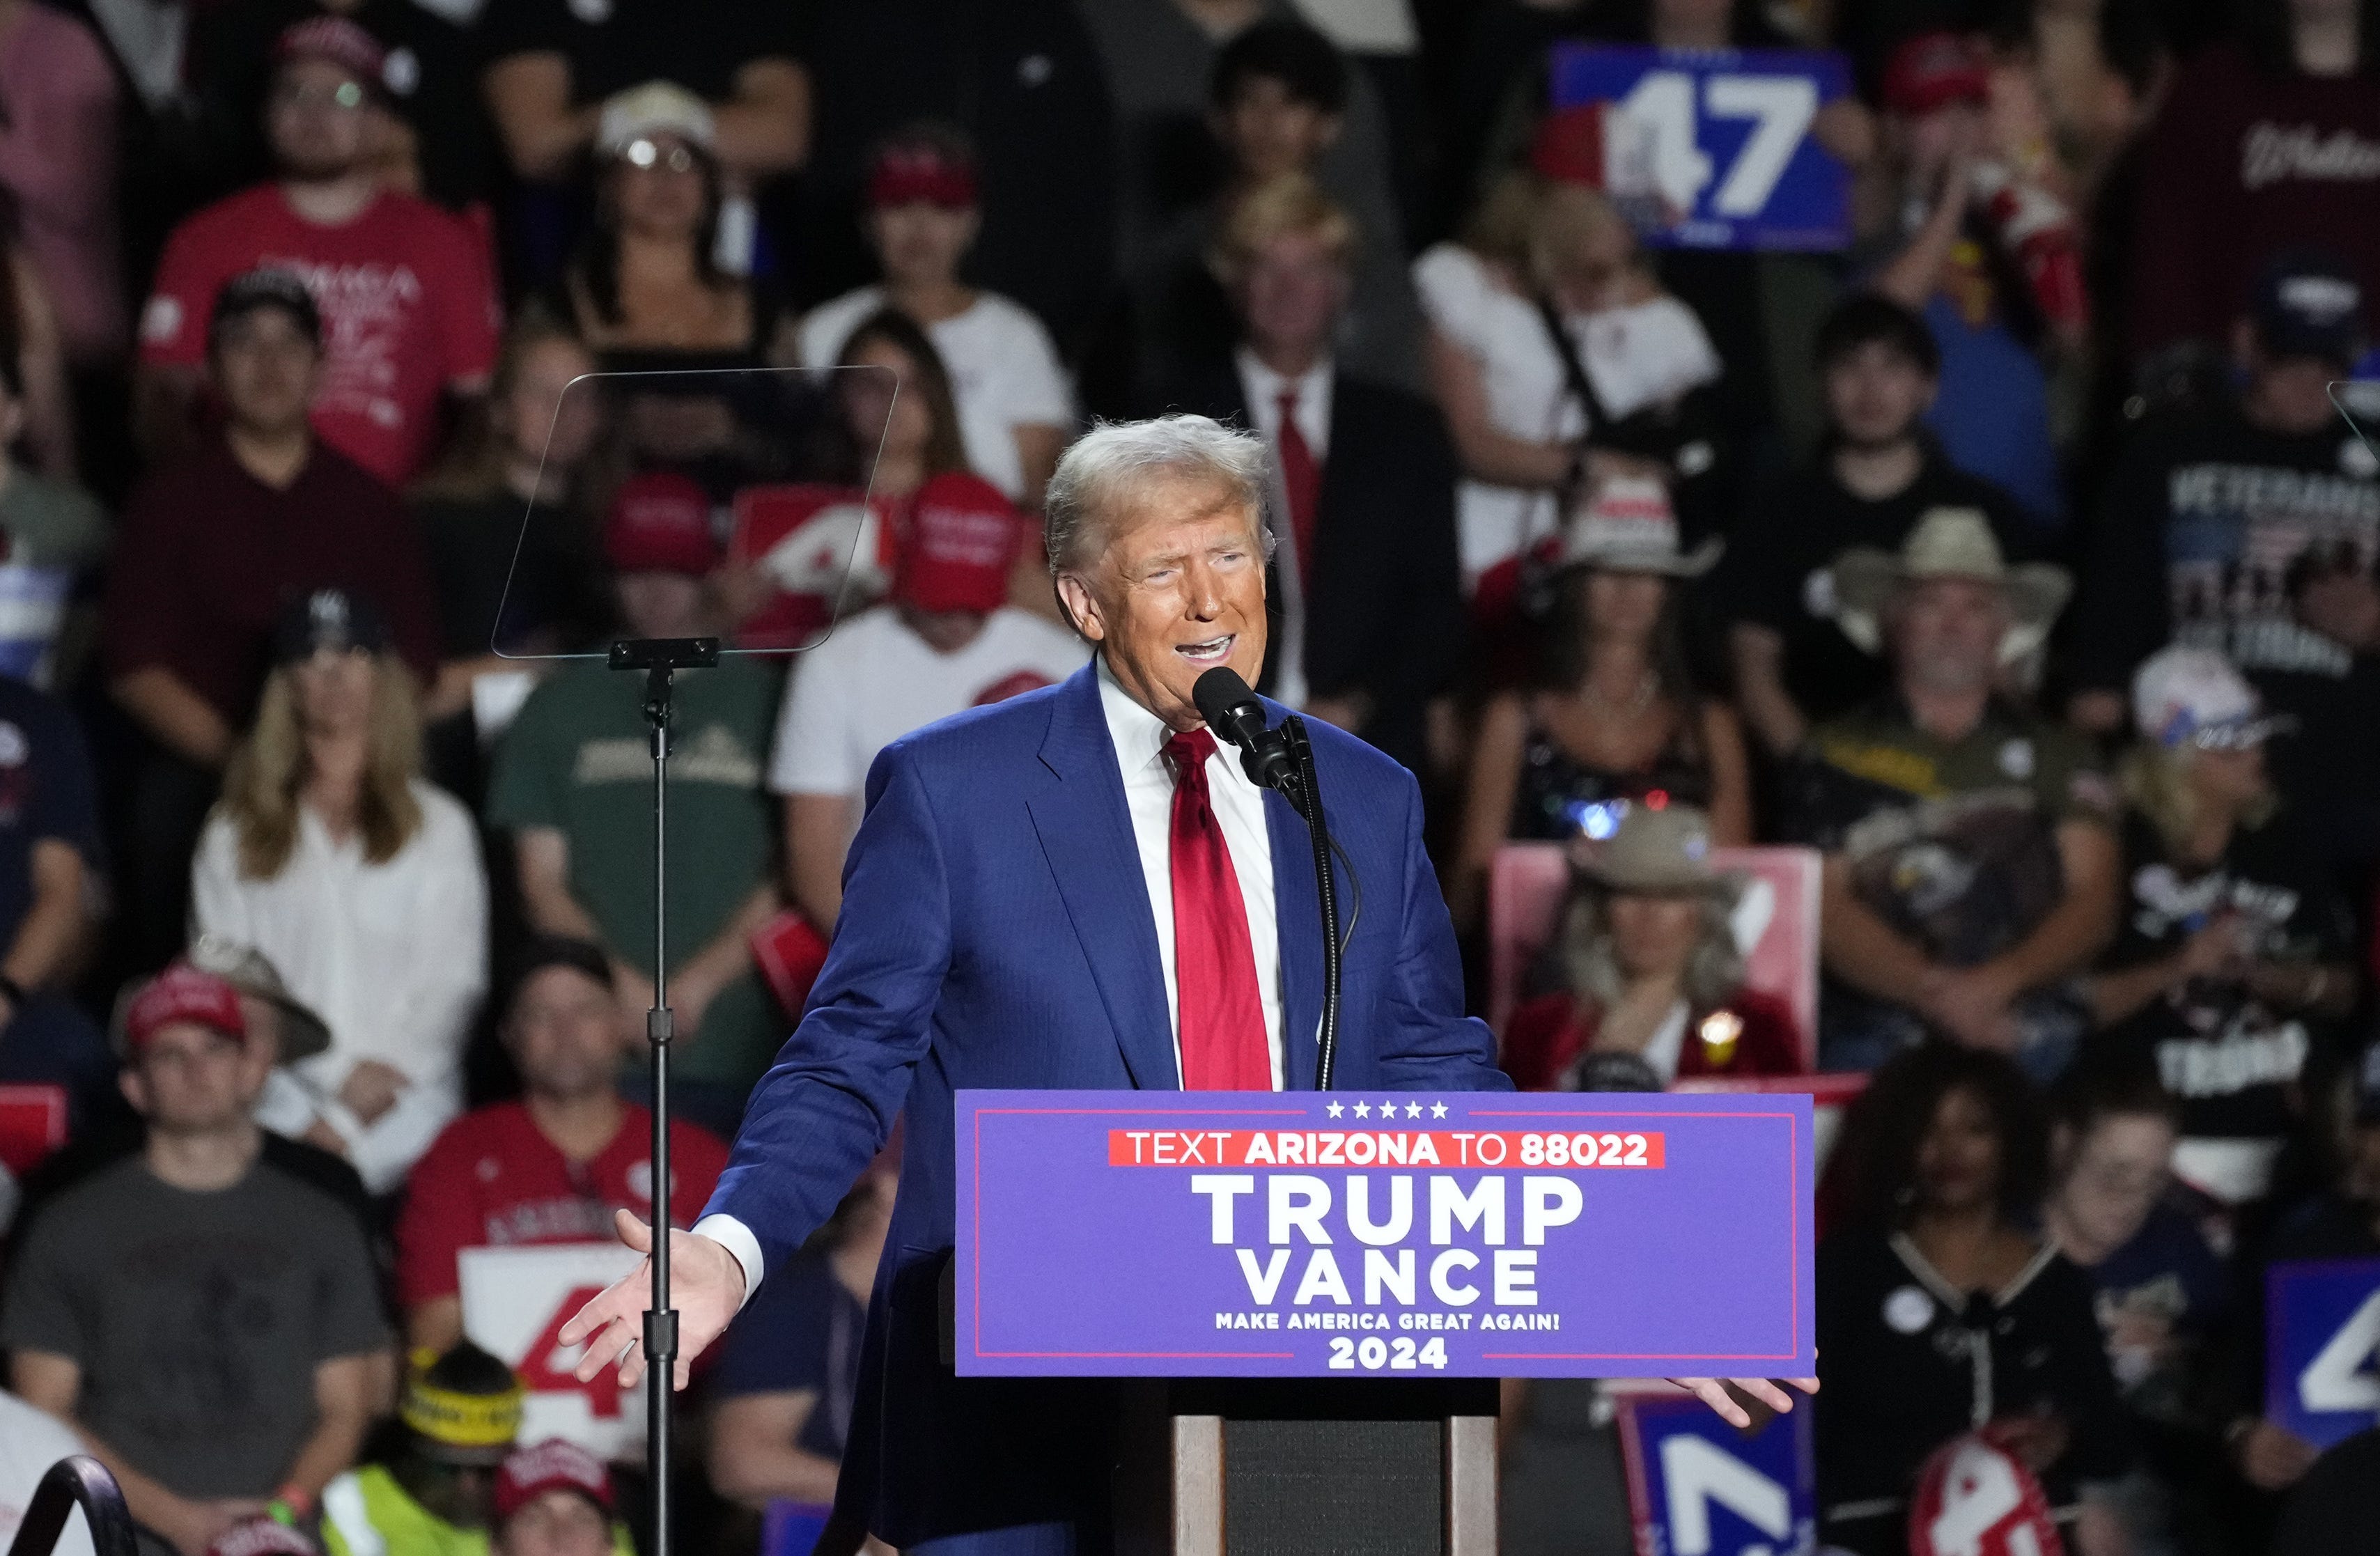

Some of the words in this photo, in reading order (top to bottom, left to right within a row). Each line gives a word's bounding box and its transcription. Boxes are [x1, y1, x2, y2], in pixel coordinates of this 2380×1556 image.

[1609, 70, 1819, 219] 47
[1126, 1131, 1232, 1164] TEXT
[1244, 1131, 1440, 1165] ARIZONA
[1452, 1133, 1507, 1166] TO
[1520, 1133, 1648, 1166] 88022
[1190, 1174, 1584, 1246] TRUMP
[1234, 1248, 1539, 1307] VANCE
[1215, 1312, 1280, 1330] MAKE
[1286, 1312, 1391, 1330] AMERICA
[1398, 1312, 1473, 1331] GREAT
[1479, 1312, 1560, 1332] AGAIN!
[1328, 1335, 1449, 1370] 2024
